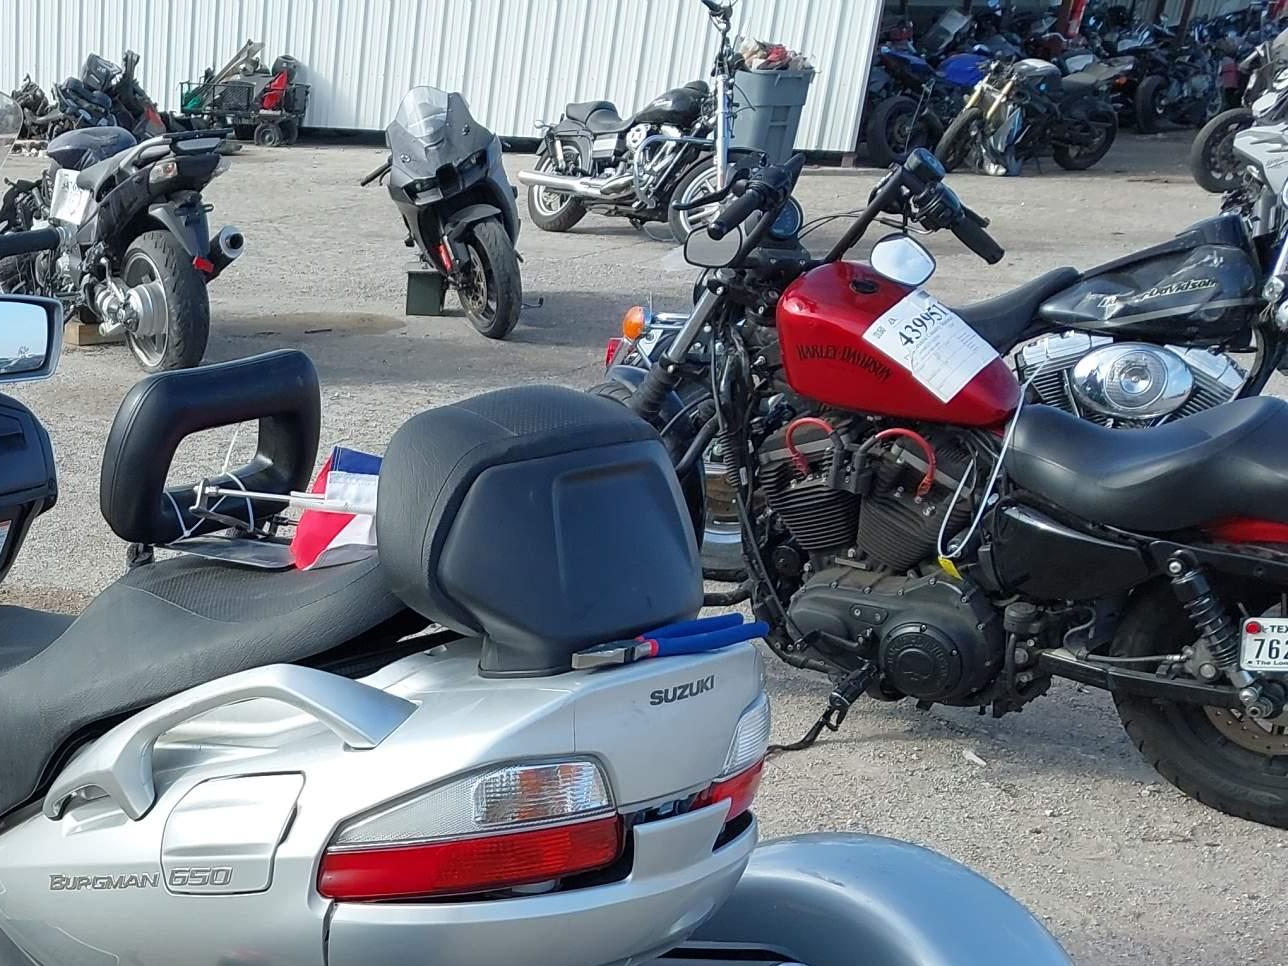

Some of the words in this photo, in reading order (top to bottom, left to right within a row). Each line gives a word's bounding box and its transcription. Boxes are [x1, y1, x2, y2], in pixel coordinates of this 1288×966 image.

[650, 675, 715, 706] SUZUKI
[49, 873, 160, 891] BURGMAN
[168, 866, 233, 887] 650
